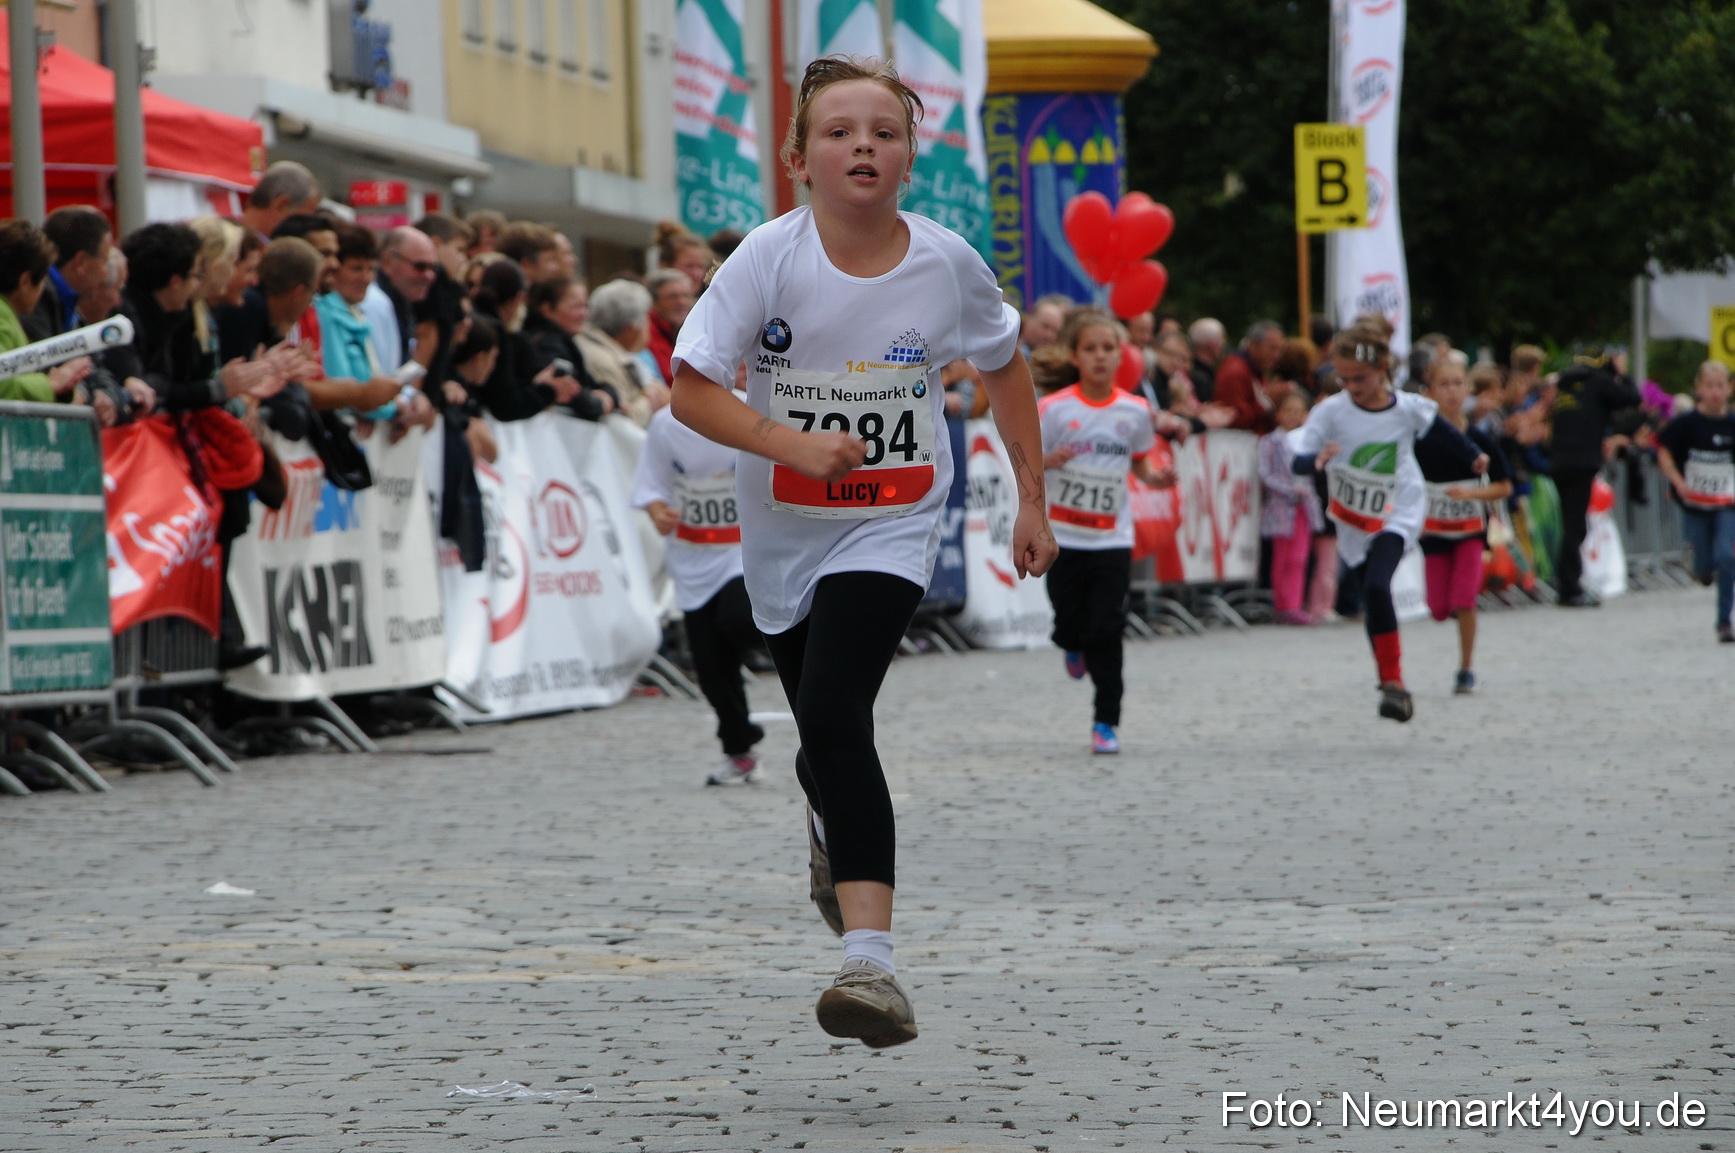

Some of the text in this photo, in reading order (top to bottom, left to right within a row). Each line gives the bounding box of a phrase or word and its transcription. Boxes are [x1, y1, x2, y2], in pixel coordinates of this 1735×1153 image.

[1304, 132, 1356, 147] Block
[1318, 159, 1349, 205] B
[774, 383, 907, 403] PARTL Neumarkt
[922, 453, 931, 462] W
[826, 481, 880, 504] Lucy
[1059, 479, 1114, 511] 7215
[1335, 475, 1385, 513] 7010
